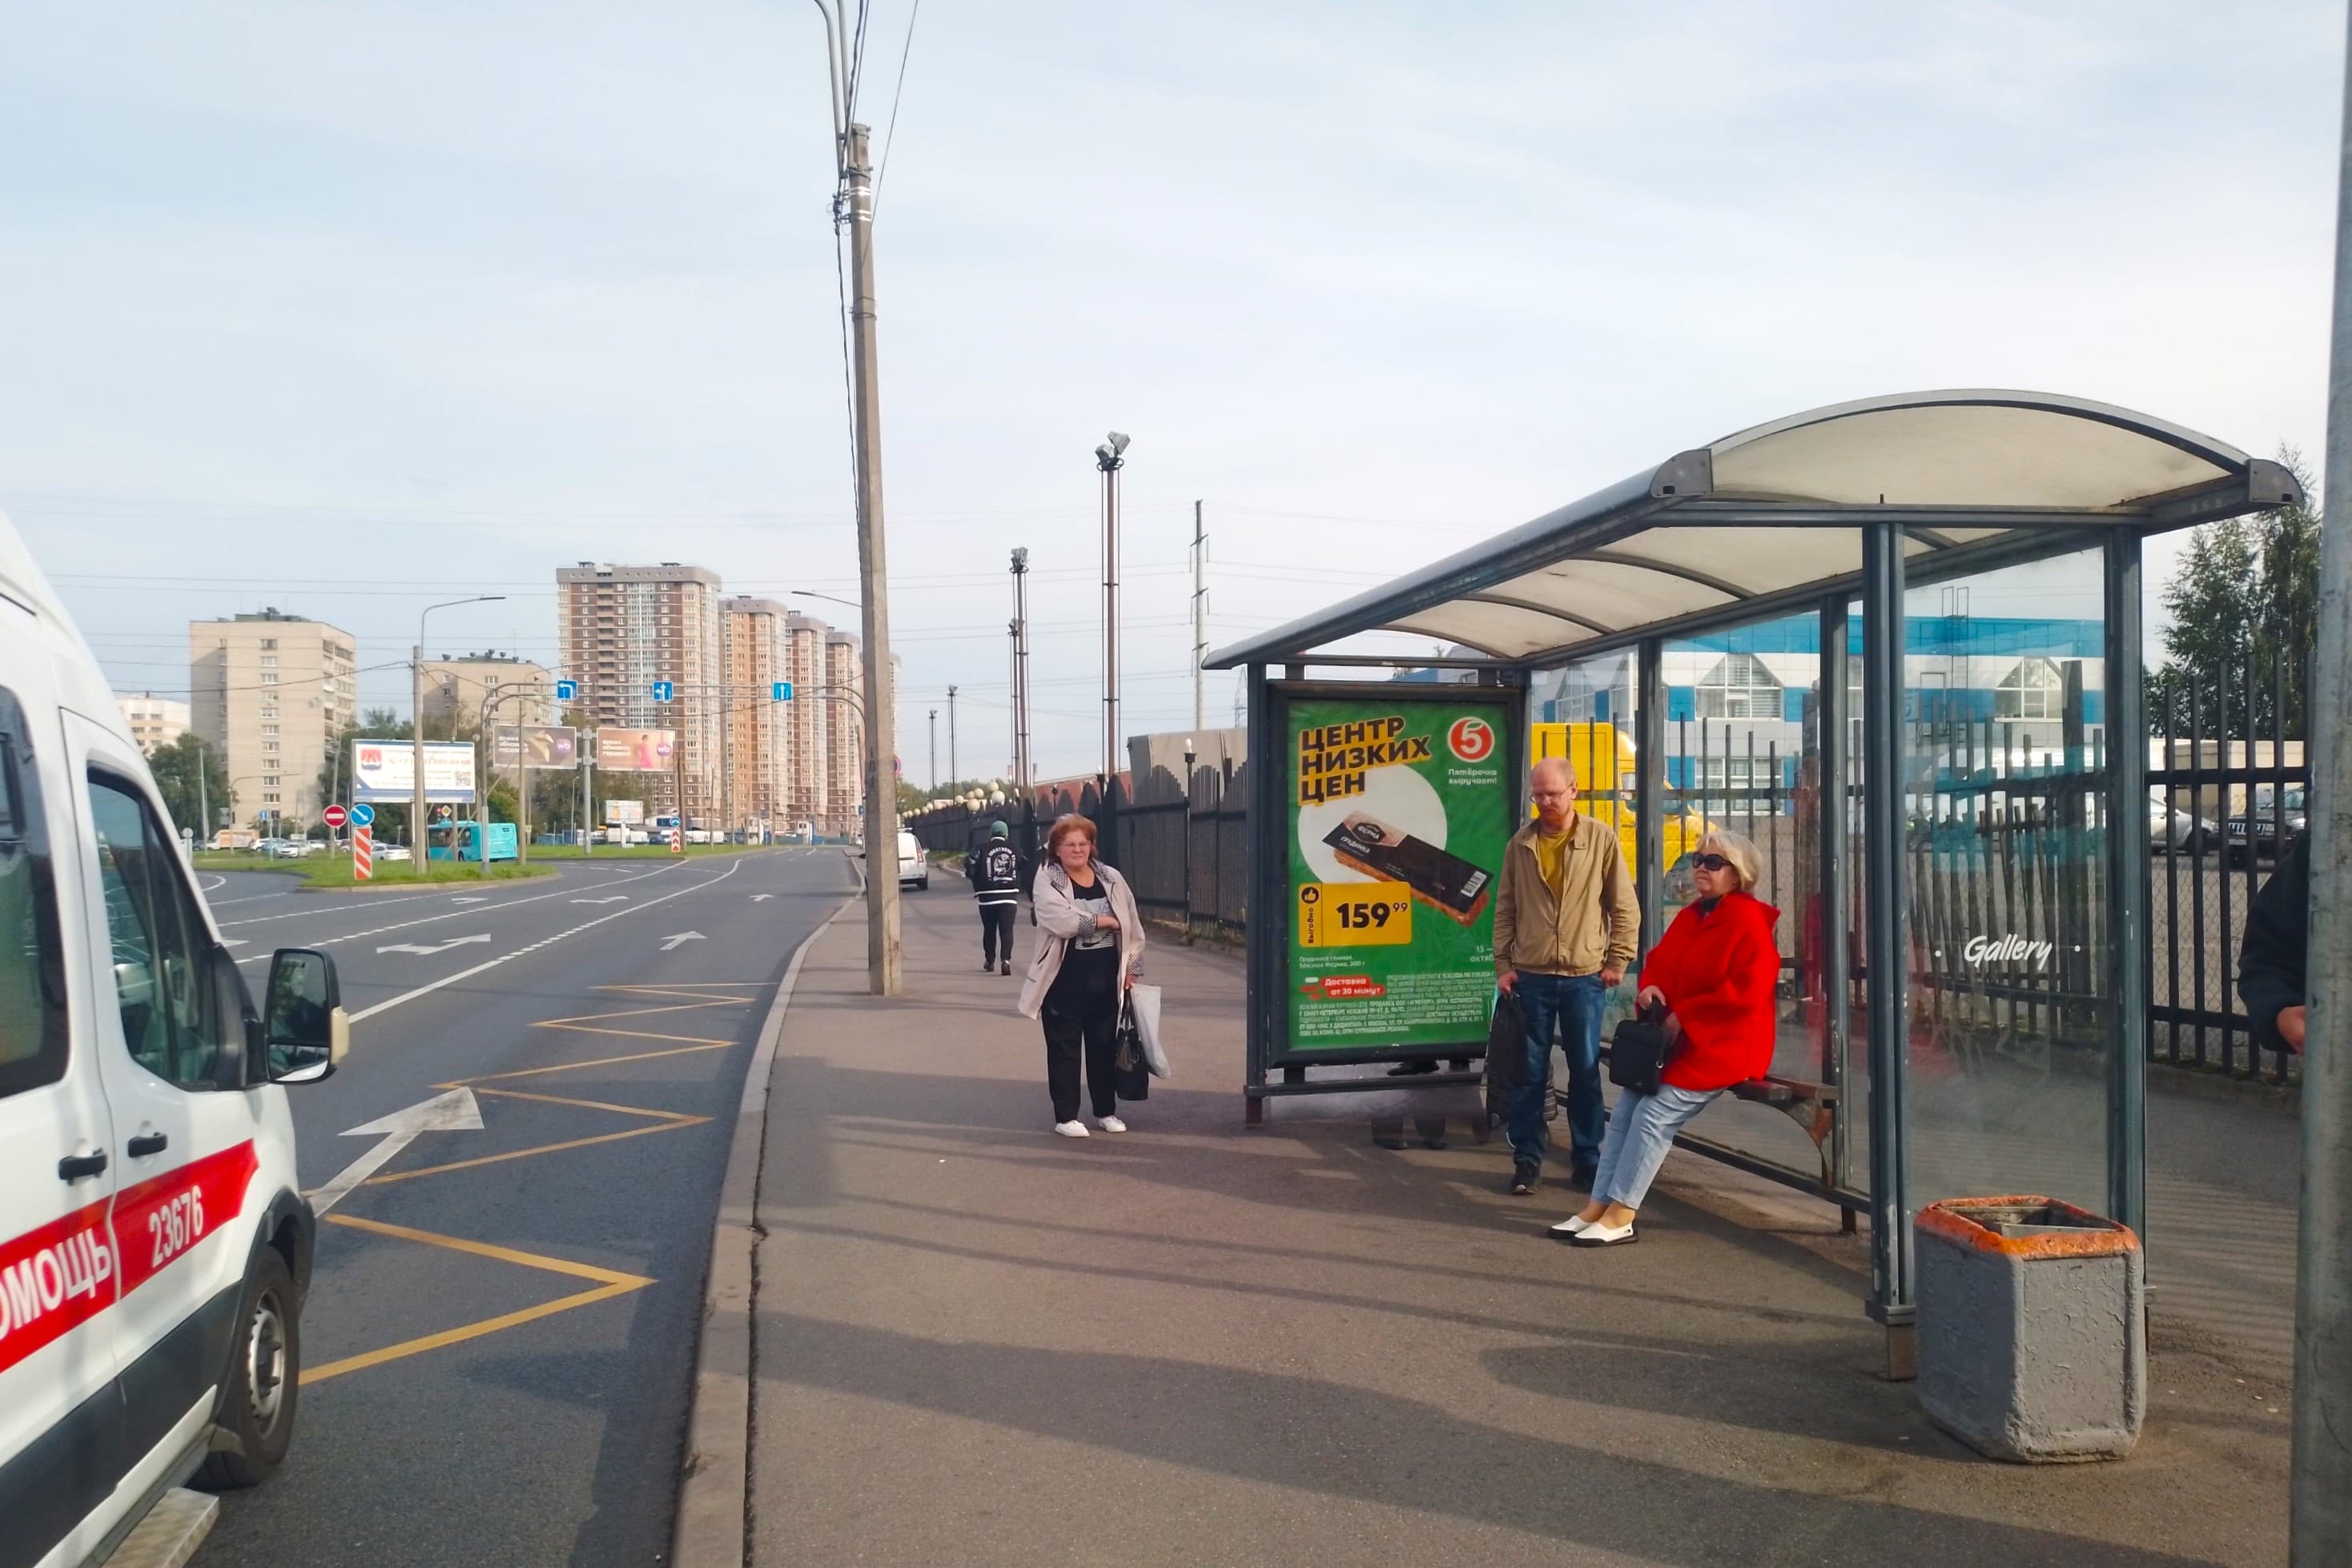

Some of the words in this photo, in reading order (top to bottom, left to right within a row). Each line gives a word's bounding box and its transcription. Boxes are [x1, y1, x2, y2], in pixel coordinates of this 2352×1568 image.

[1301, 718, 1405, 752] ЦЕНТР
[1461, 722, 1483, 754] 5
[1301, 736, 1431, 776] НИЗКИХ
[1301, 771, 1365, 802] ЦЕН
[1448, 768, 1498, 778] Пятёрочка
[1448, 778, 1498, 786] выручает!
[1337, 903, 1391, 929] 159
[1393, 903, 1408, 912] 99
[1469, 953, 1494, 963] октяб
[1964, 933, 2052, 971] Gallery
[1325, 978, 1367, 987] Доставка
[1353, 987, 1381, 995] минут
[148, 1185, 203, 1268] 23676
